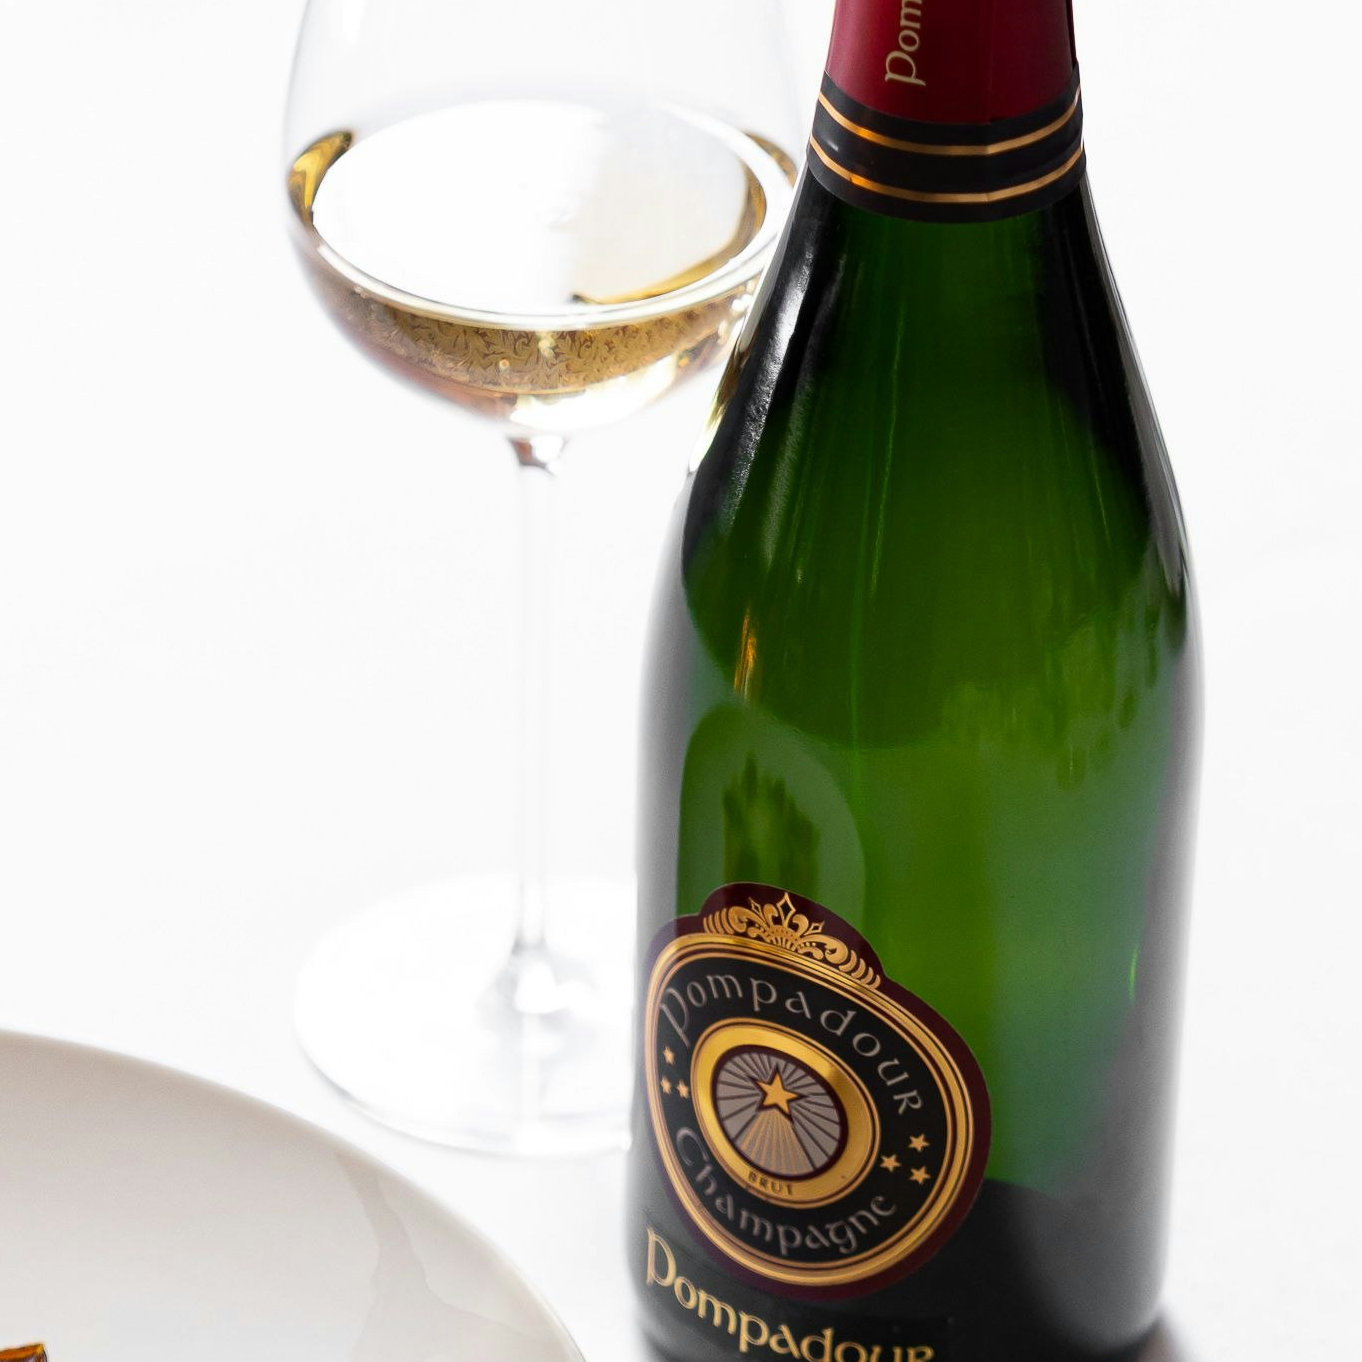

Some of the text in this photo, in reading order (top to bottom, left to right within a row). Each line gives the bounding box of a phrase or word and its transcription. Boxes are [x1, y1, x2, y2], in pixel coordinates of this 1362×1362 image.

[659, 973, 922, 1115] Pompadour
[676, 1127, 897, 1255] Champagne
[748, 1170, 794, 1195] BRUT
